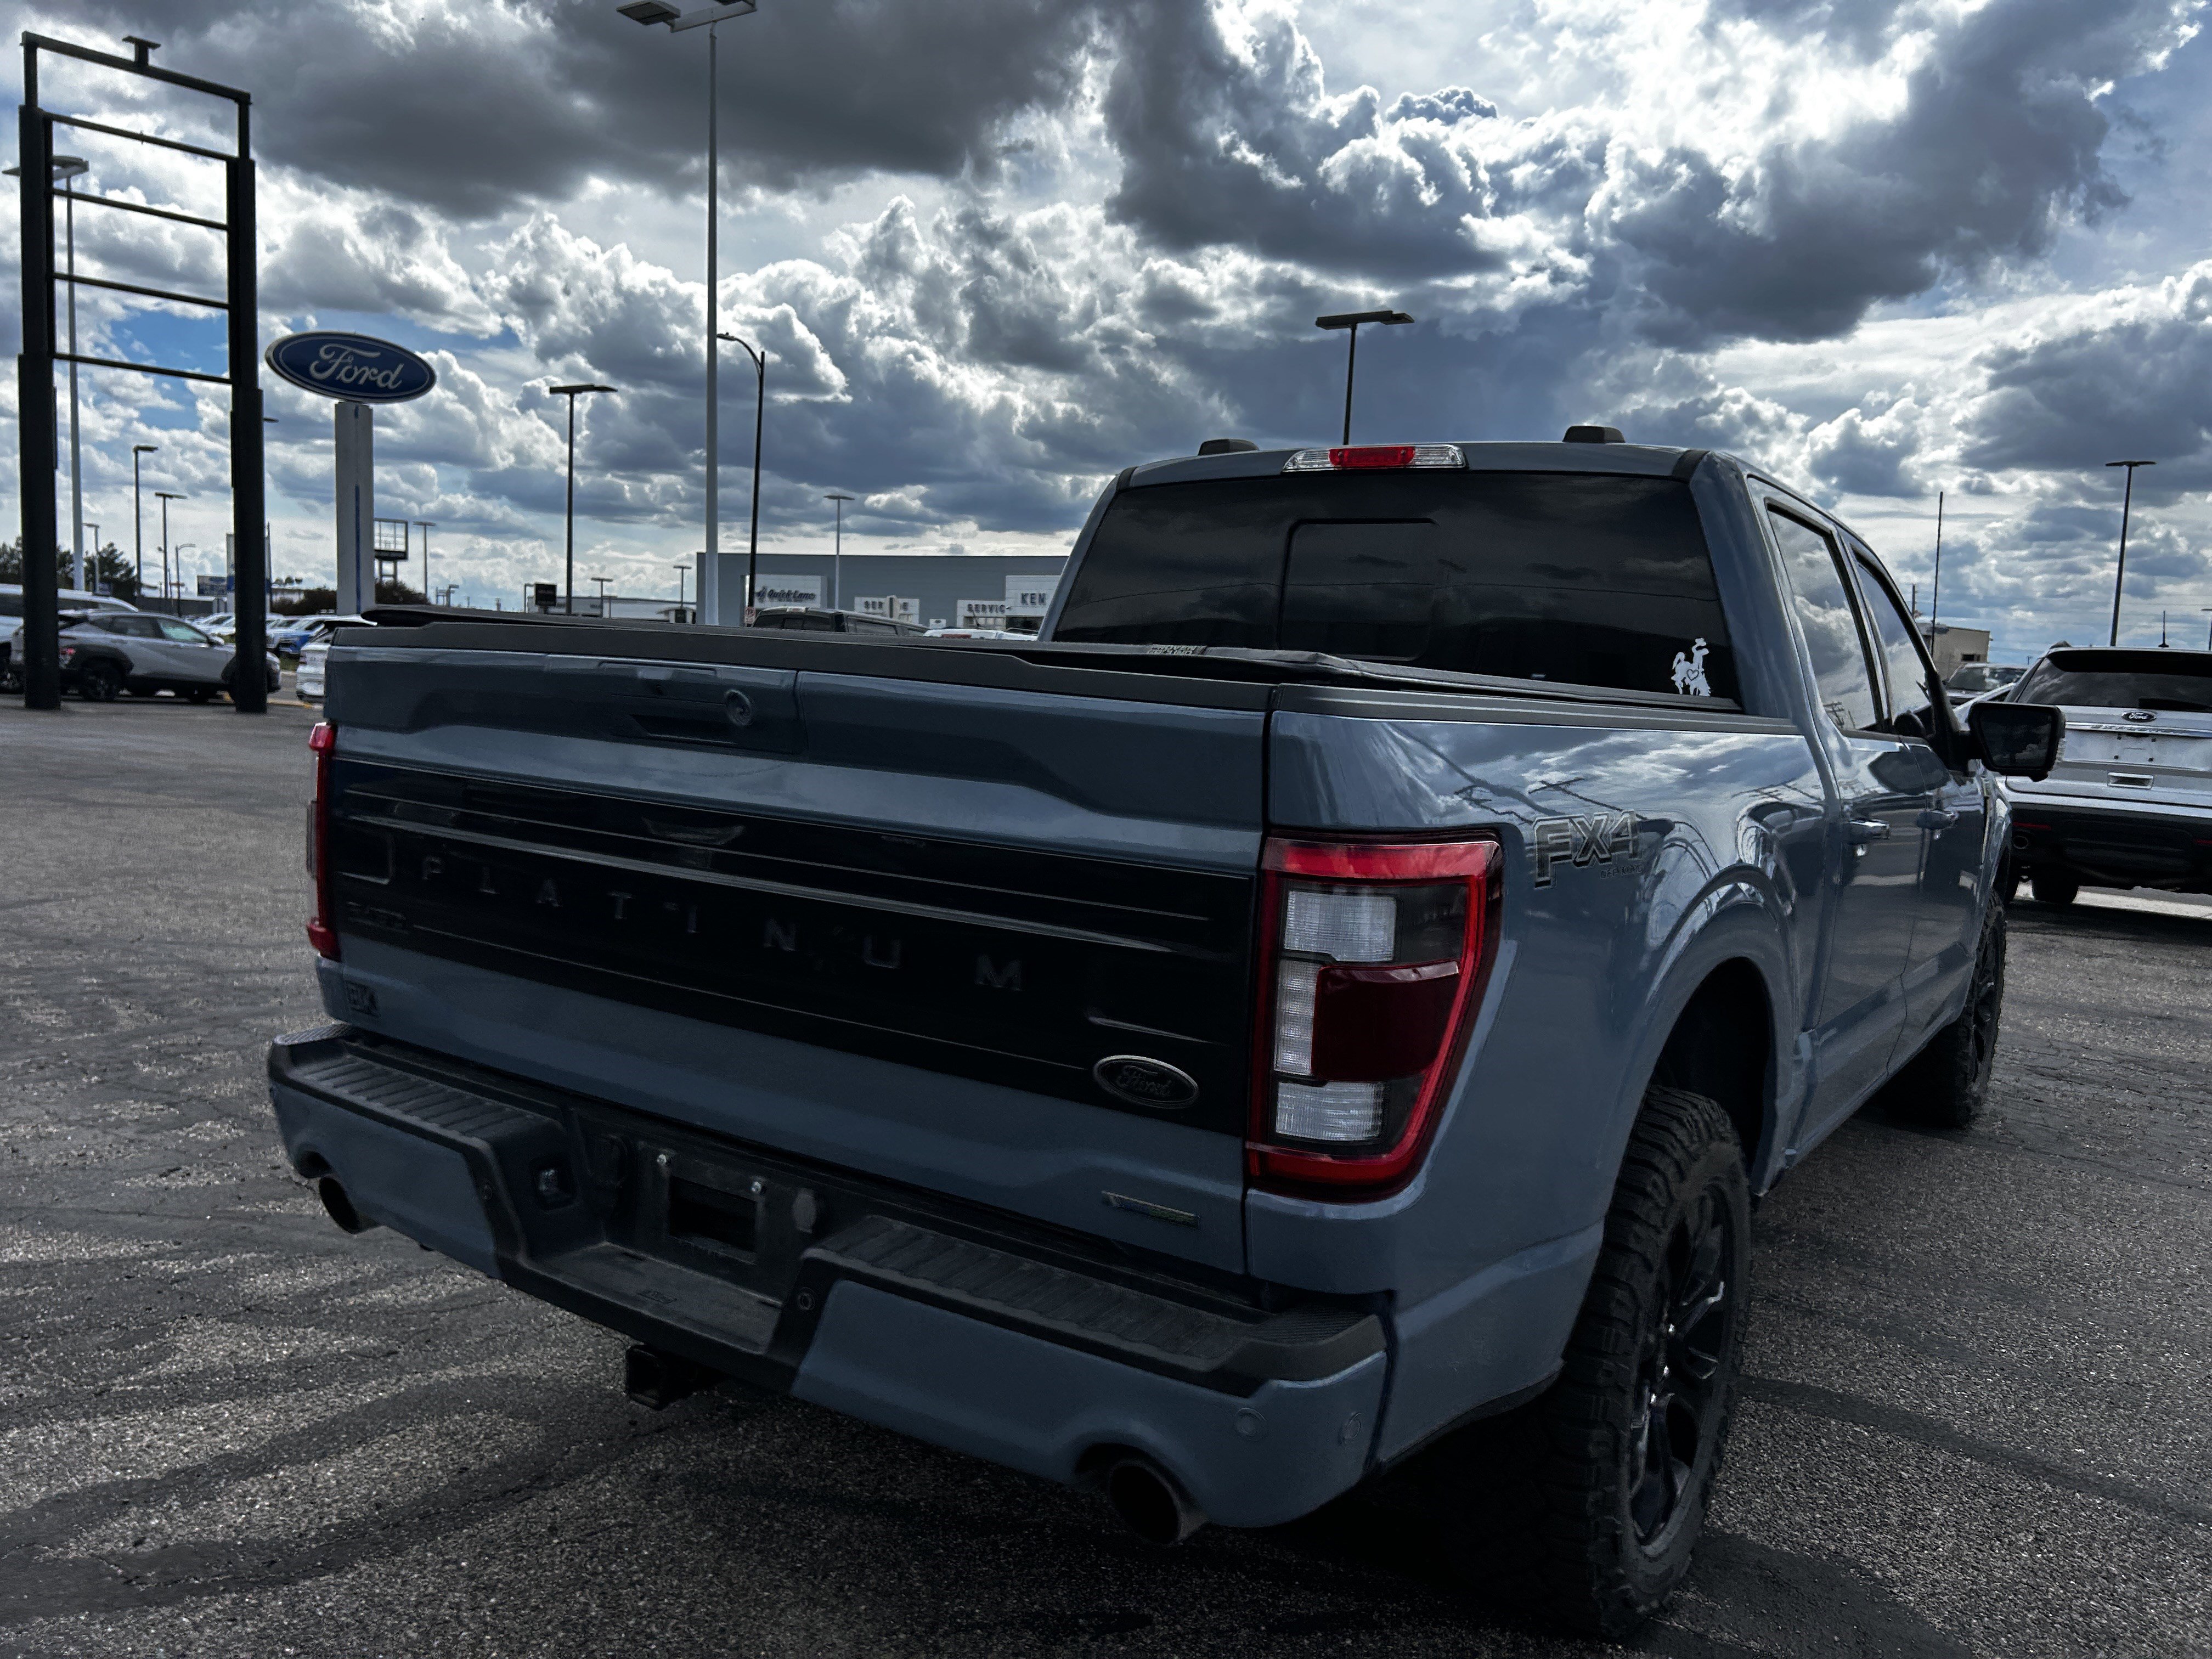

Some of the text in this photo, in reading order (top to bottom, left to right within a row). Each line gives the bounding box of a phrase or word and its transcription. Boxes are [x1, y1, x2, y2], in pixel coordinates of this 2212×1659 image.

[309, 343, 405, 390] Ford
[768, 589, 792, 600] Quick
[1020, 592, 1046, 606] KEN
[967, 603, 1006, 614] SERVIC
[2128, 712, 2149, 720] Ford
[1534, 809, 1643, 890] FX4
[421, 854, 1024, 992] PLATINUM
[1116, 1065, 1173, 1097] Ford
